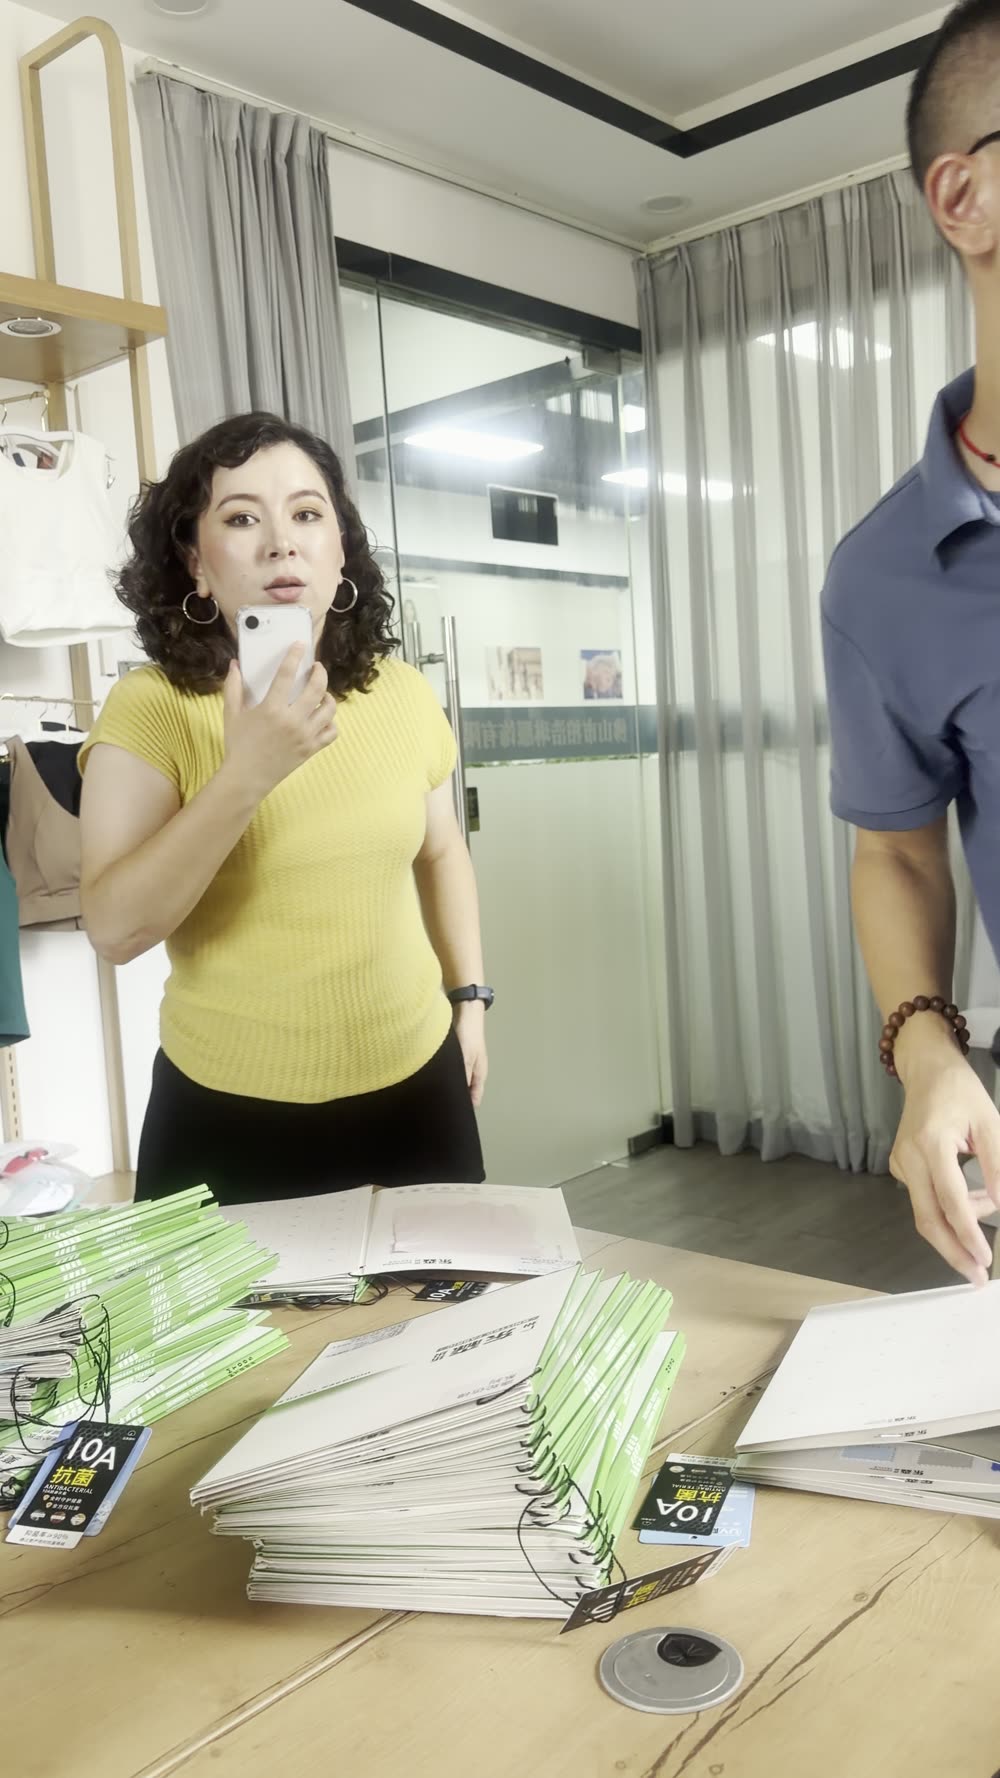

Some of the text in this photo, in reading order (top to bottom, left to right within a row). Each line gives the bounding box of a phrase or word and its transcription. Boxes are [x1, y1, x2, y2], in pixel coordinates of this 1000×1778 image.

[67, 1437, 117, 1470] 10A
[50, 1466, 98, 1487] 抗菌
[43, 1484, 94, 1495] ANTIBACTERIAL
[671, 1483, 726, 1493] ANTIBACTERIAL
[674, 1488, 722, 1504] 抗菌
[656, 1498, 713, 1523] 10A
